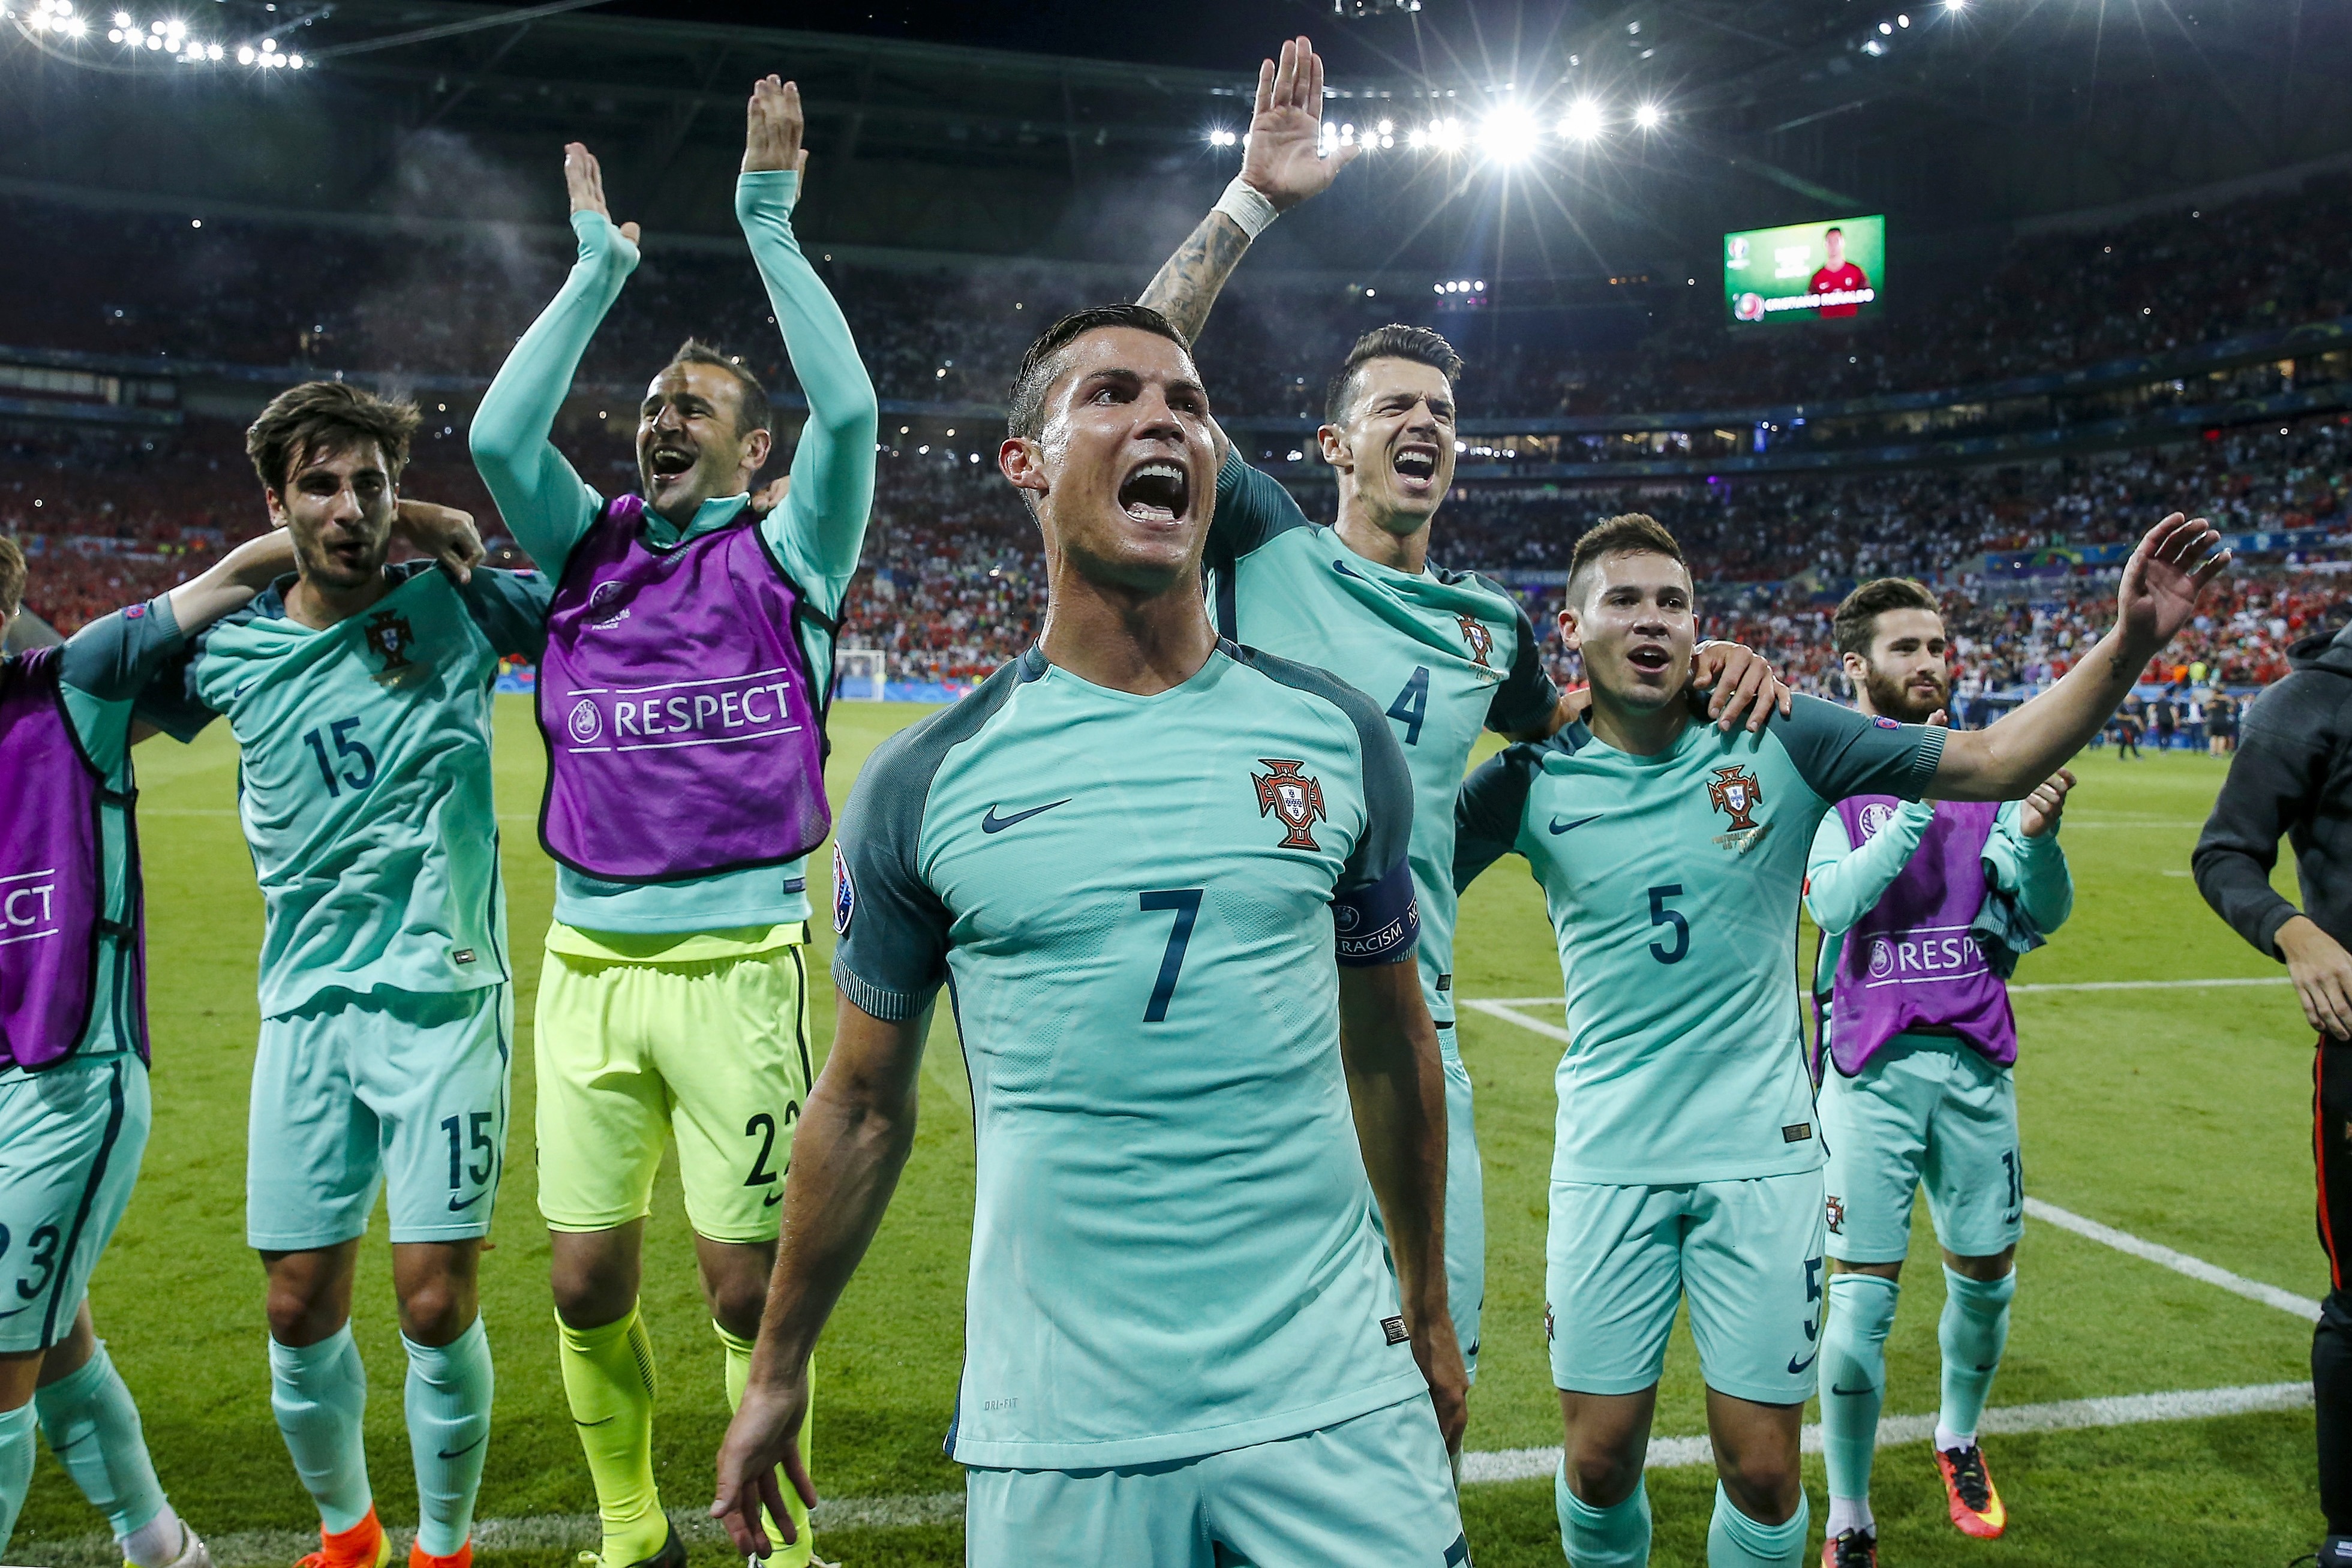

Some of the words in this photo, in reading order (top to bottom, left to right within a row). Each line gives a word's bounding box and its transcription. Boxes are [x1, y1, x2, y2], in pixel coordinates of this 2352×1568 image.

[614, 681, 791, 738] RESPECT
[1385, 665, 1430, 746] 4
[303, 716, 376, 798] 15
[1139, 889, 1204, 1022] 7
[1342, 923, 1403, 953] RACISM
[1648, 884, 1690, 965] 5
[441, 1112, 493, 1189] 15
[1804, 1256, 1822, 1342] 5
[984, 1397, 1019, 1411] DRI-FIT
